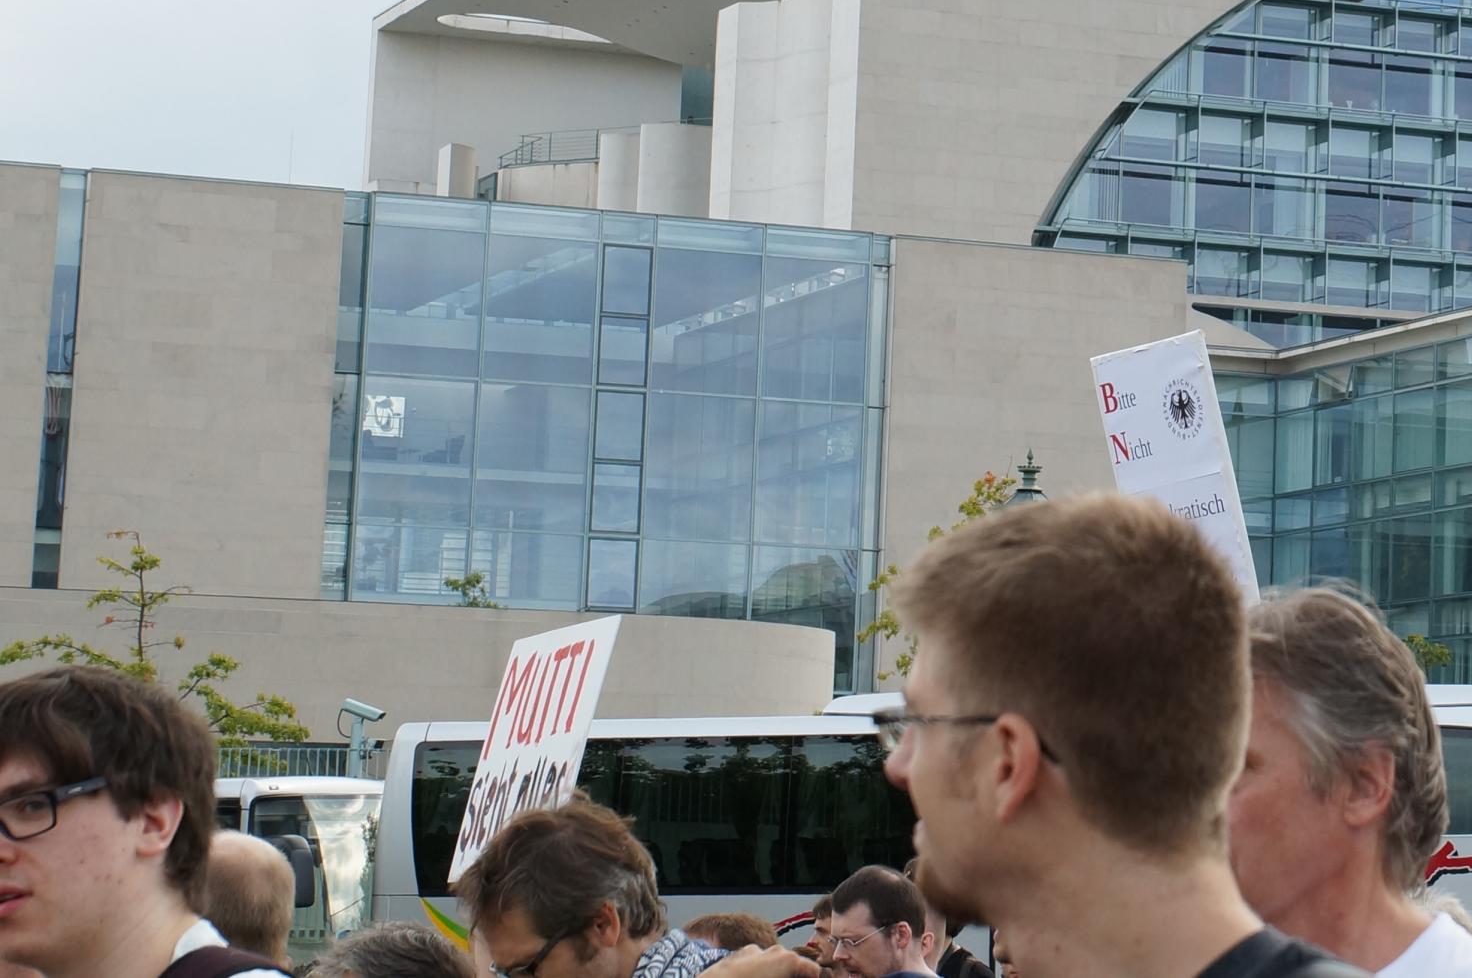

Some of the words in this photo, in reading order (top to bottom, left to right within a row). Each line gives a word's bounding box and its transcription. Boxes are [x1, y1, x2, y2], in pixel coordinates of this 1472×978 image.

[1099, 382, 1137, 414] Bitte
[1109, 431, 1153, 465] Nicht
[1168, 493, 1226, 520] kratisch
